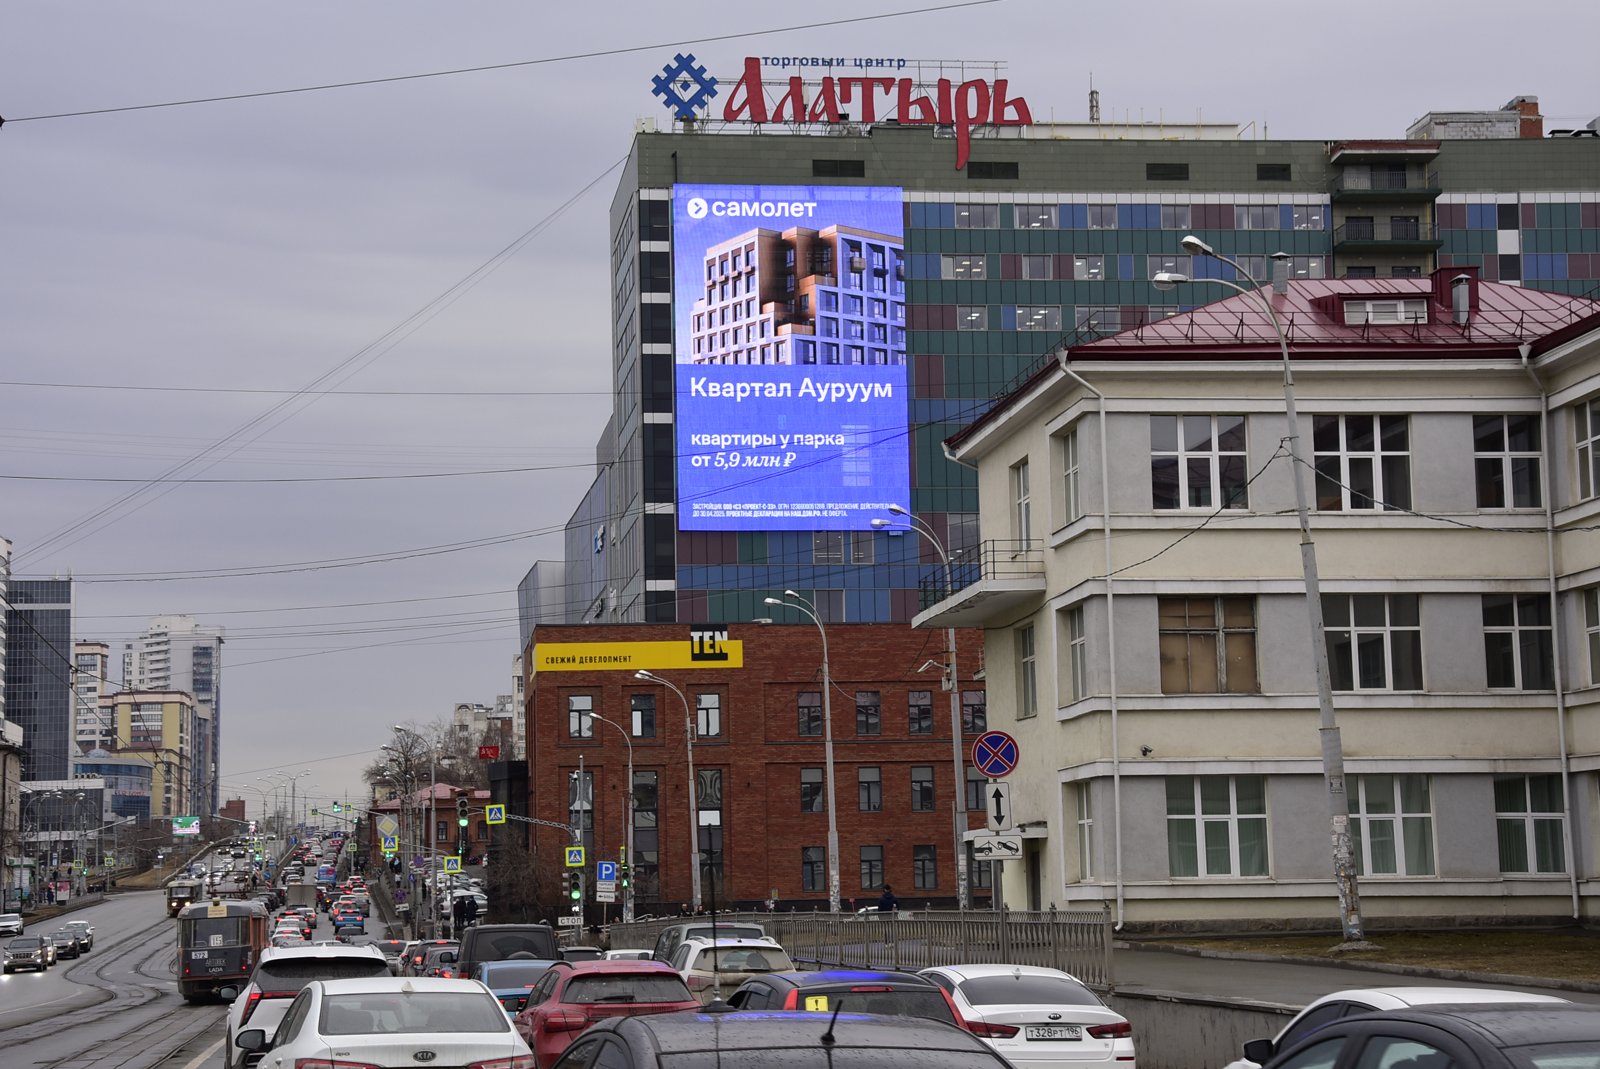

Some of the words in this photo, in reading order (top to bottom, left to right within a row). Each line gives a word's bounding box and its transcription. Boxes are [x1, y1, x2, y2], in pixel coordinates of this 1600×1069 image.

[853, 58, 906, 70] центр
[723, 57, 1033, 171] Алатырь
[711, 200, 817, 218] самолет
[690, 376, 791, 402] Квартал
[797, 377, 893, 403] Ауруум
[691, 433, 776, 449] квартиры
[779, 434, 791, 449] у
[793, 434, 845, 449] парка
[691, 456, 712, 467] от
[714, 452, 740, 470] 5,9
[742, 456, 781, 468] млн
[690, 631, 728, 654] TEN
[545, 655, 576, 665] СВЕЖИЙ
[578, 655, 632, 665] ДЕВЕЛОПМЕНТ
[560, 917, 582, 925] СТОП
[416, 1052, 433, 1060] KIA
